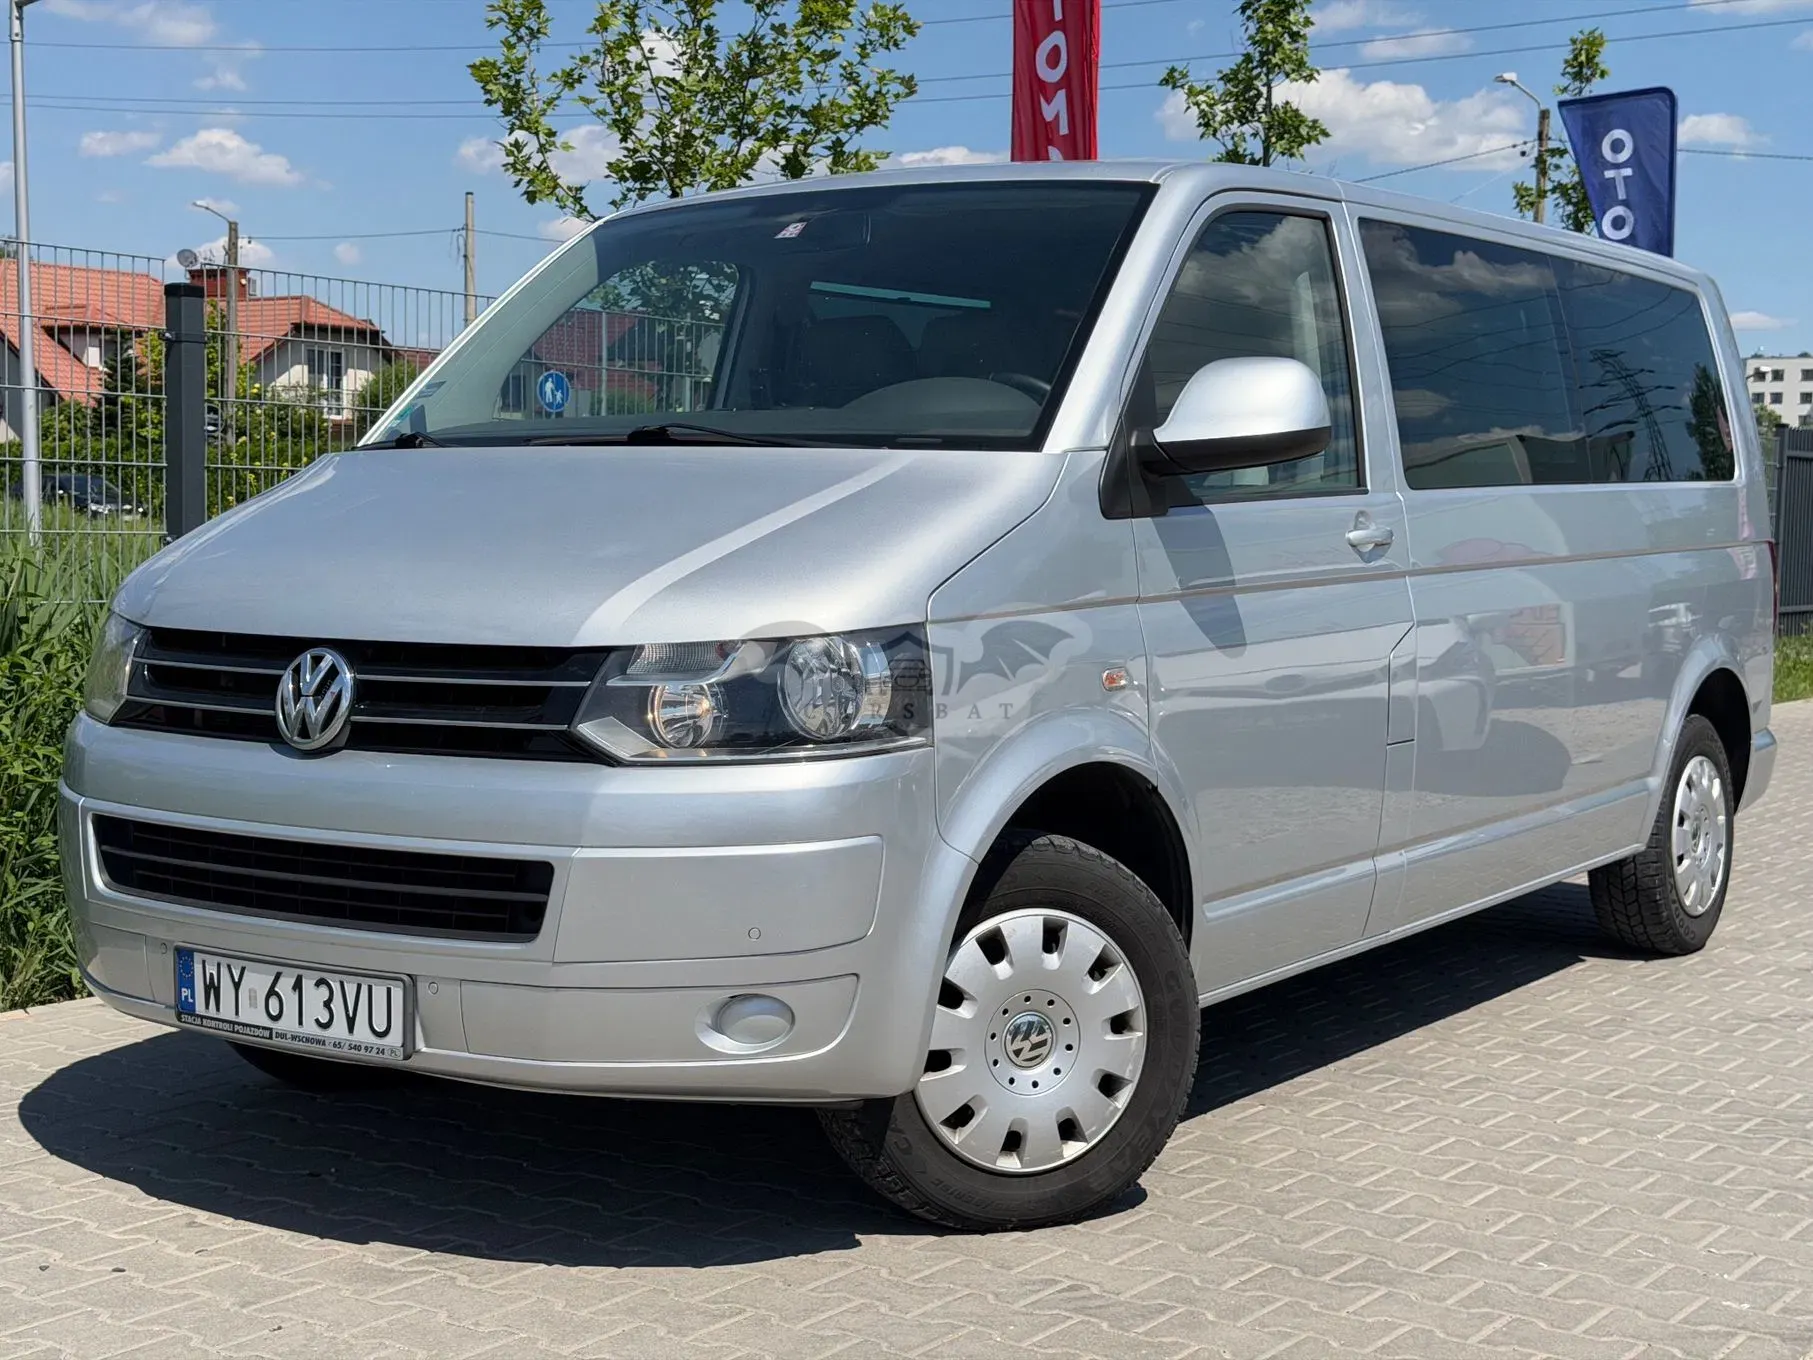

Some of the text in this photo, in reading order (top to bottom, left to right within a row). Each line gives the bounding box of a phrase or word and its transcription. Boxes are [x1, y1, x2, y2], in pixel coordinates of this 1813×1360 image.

[1602, 129, 1634, 240] OTO
[181, 988, 194, 1003] PL
[202, 959, 392, 1038] WY 613VU
[181, 1014, 270, 1038] STACJA KONTROLI POJAZDÓW
[364, 1046, 374, 1054] 97
[376, 1048, 385, 1056] 24
